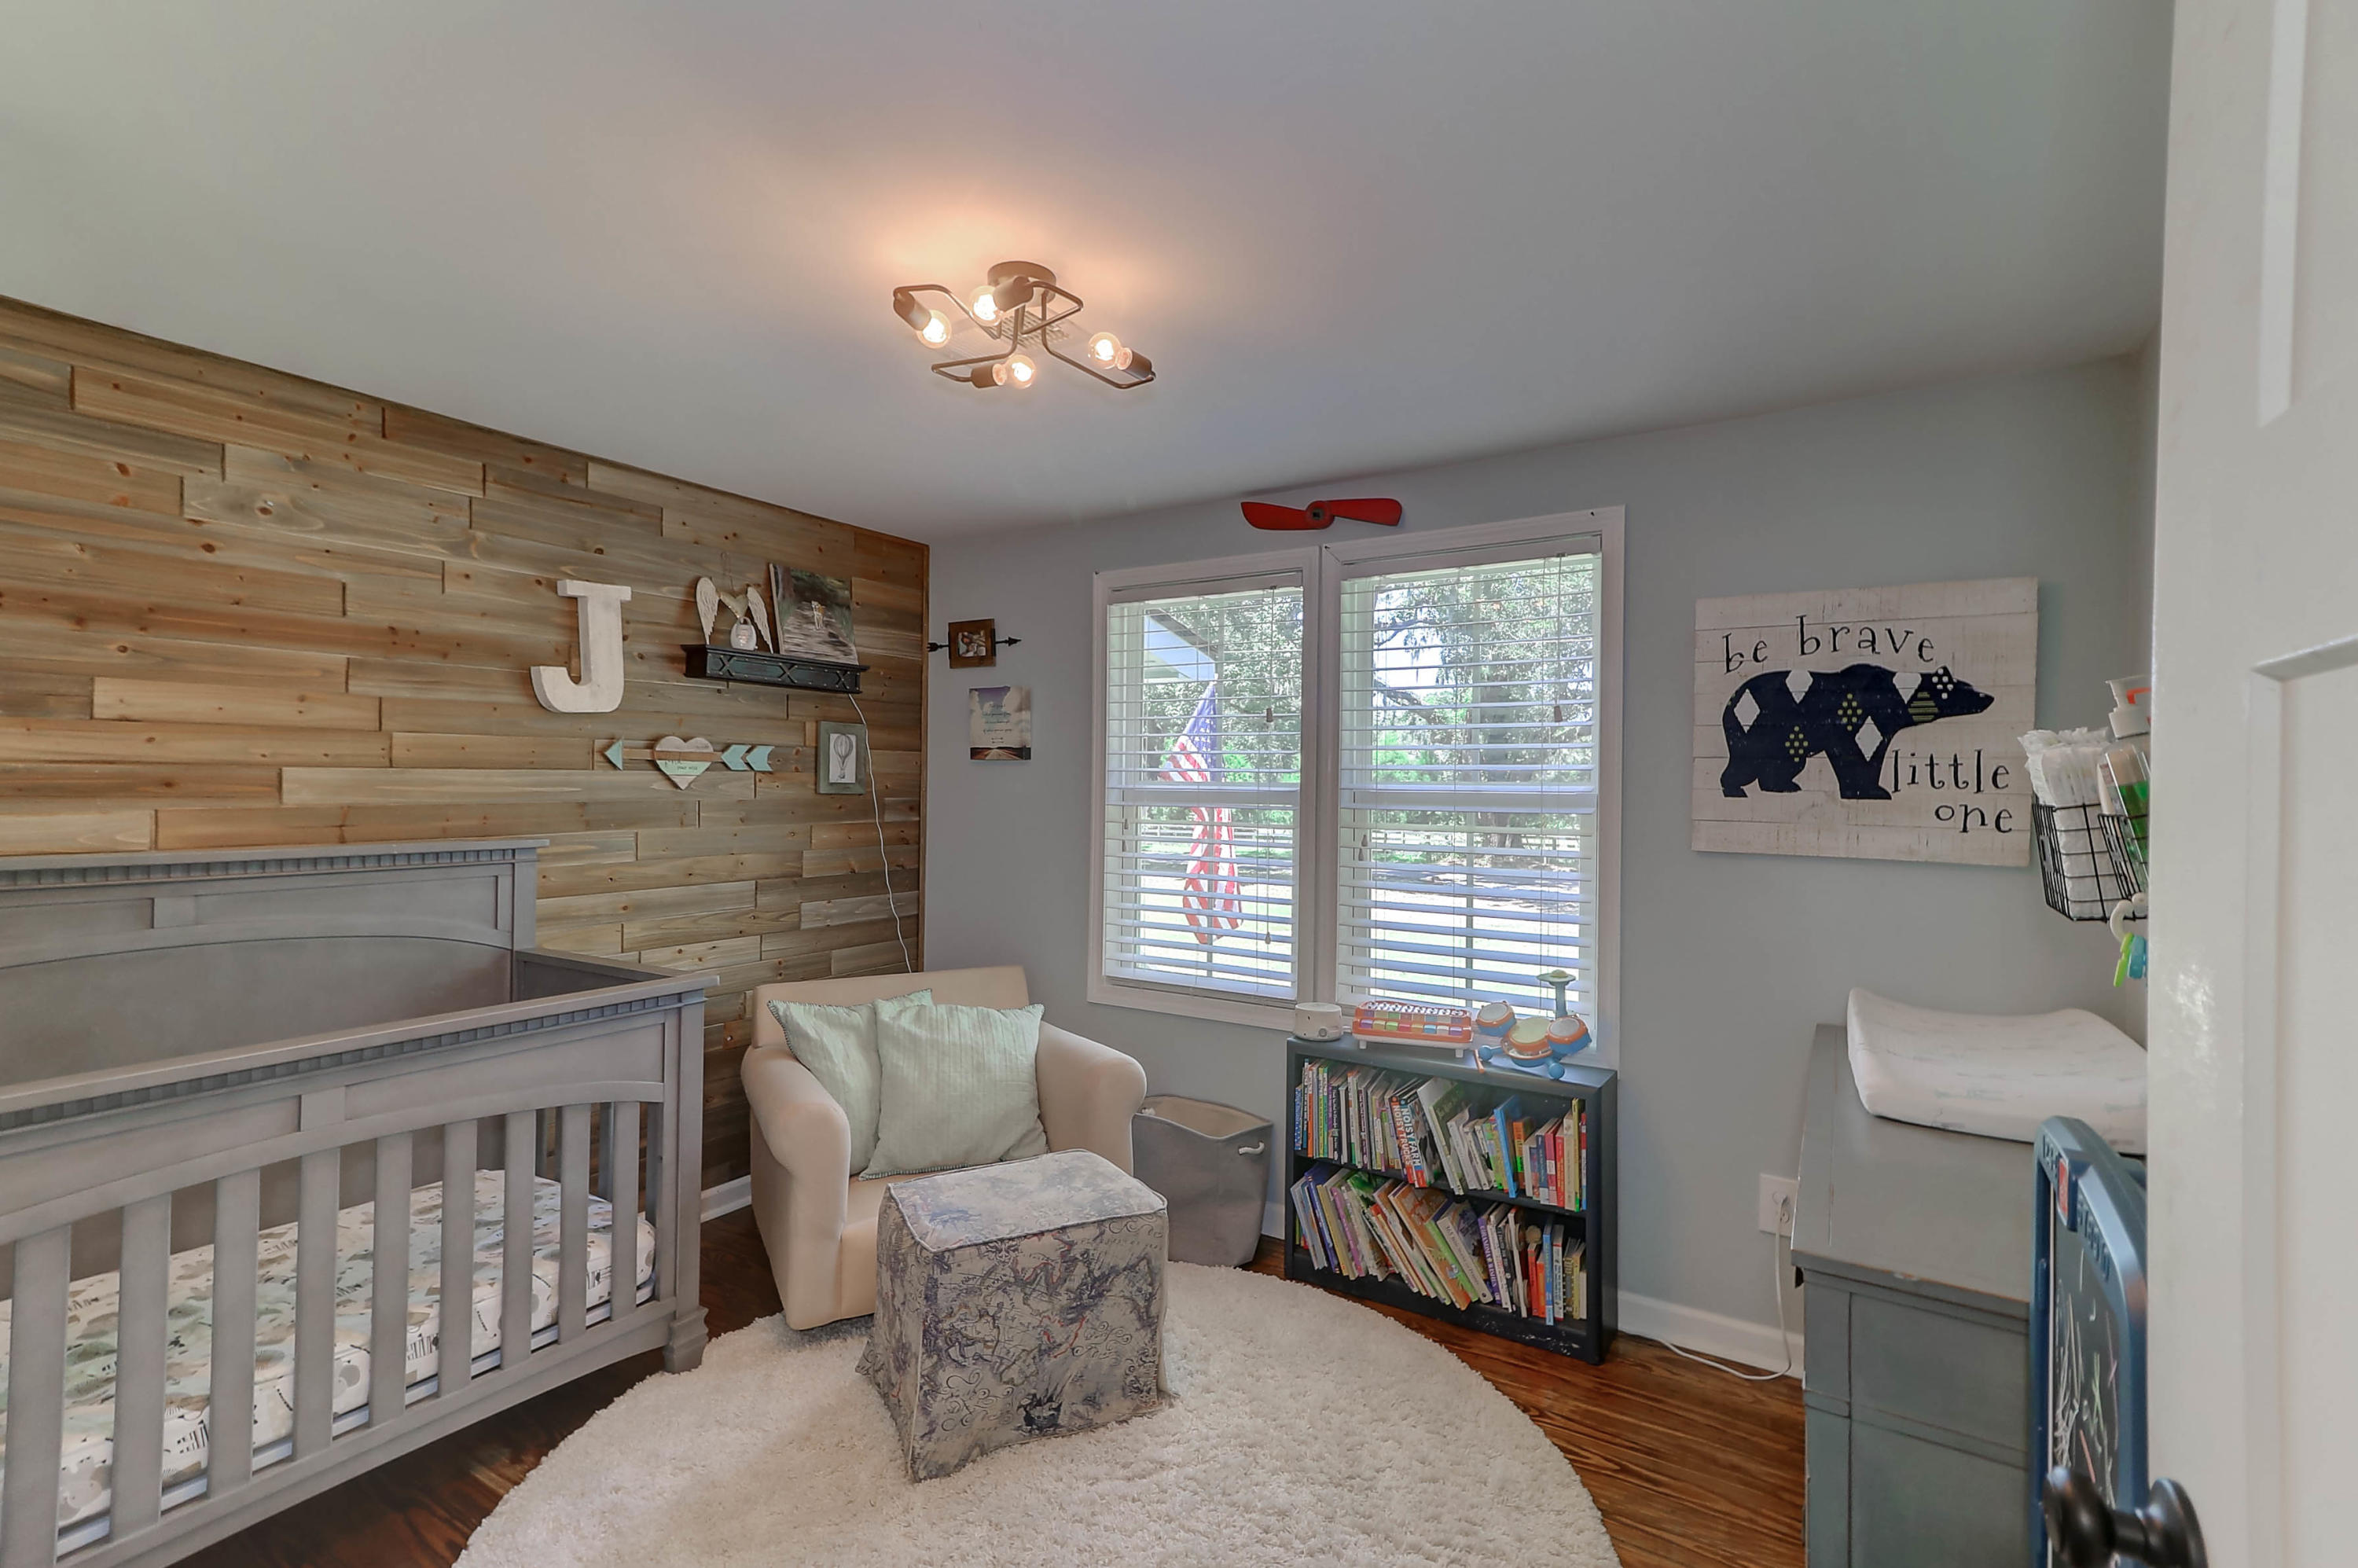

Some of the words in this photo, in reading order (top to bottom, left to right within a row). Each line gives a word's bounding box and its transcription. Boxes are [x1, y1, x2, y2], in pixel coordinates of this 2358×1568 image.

[530, 579, 632, 714] J
[1722, 633, 1768, 674] be
[1796, 615, 1934, 663] brave
[1891, 749, 2010, 794] little
[1934, 804, 2013, 833] one
[1392, 1104, 1405, 1133] NOISY
[1401, 1107, 1415, 1139] NOISY
[1409, 1140, 1420, 1166] FARM
[1398, 1132, 1412, 1165] TRUCKS
